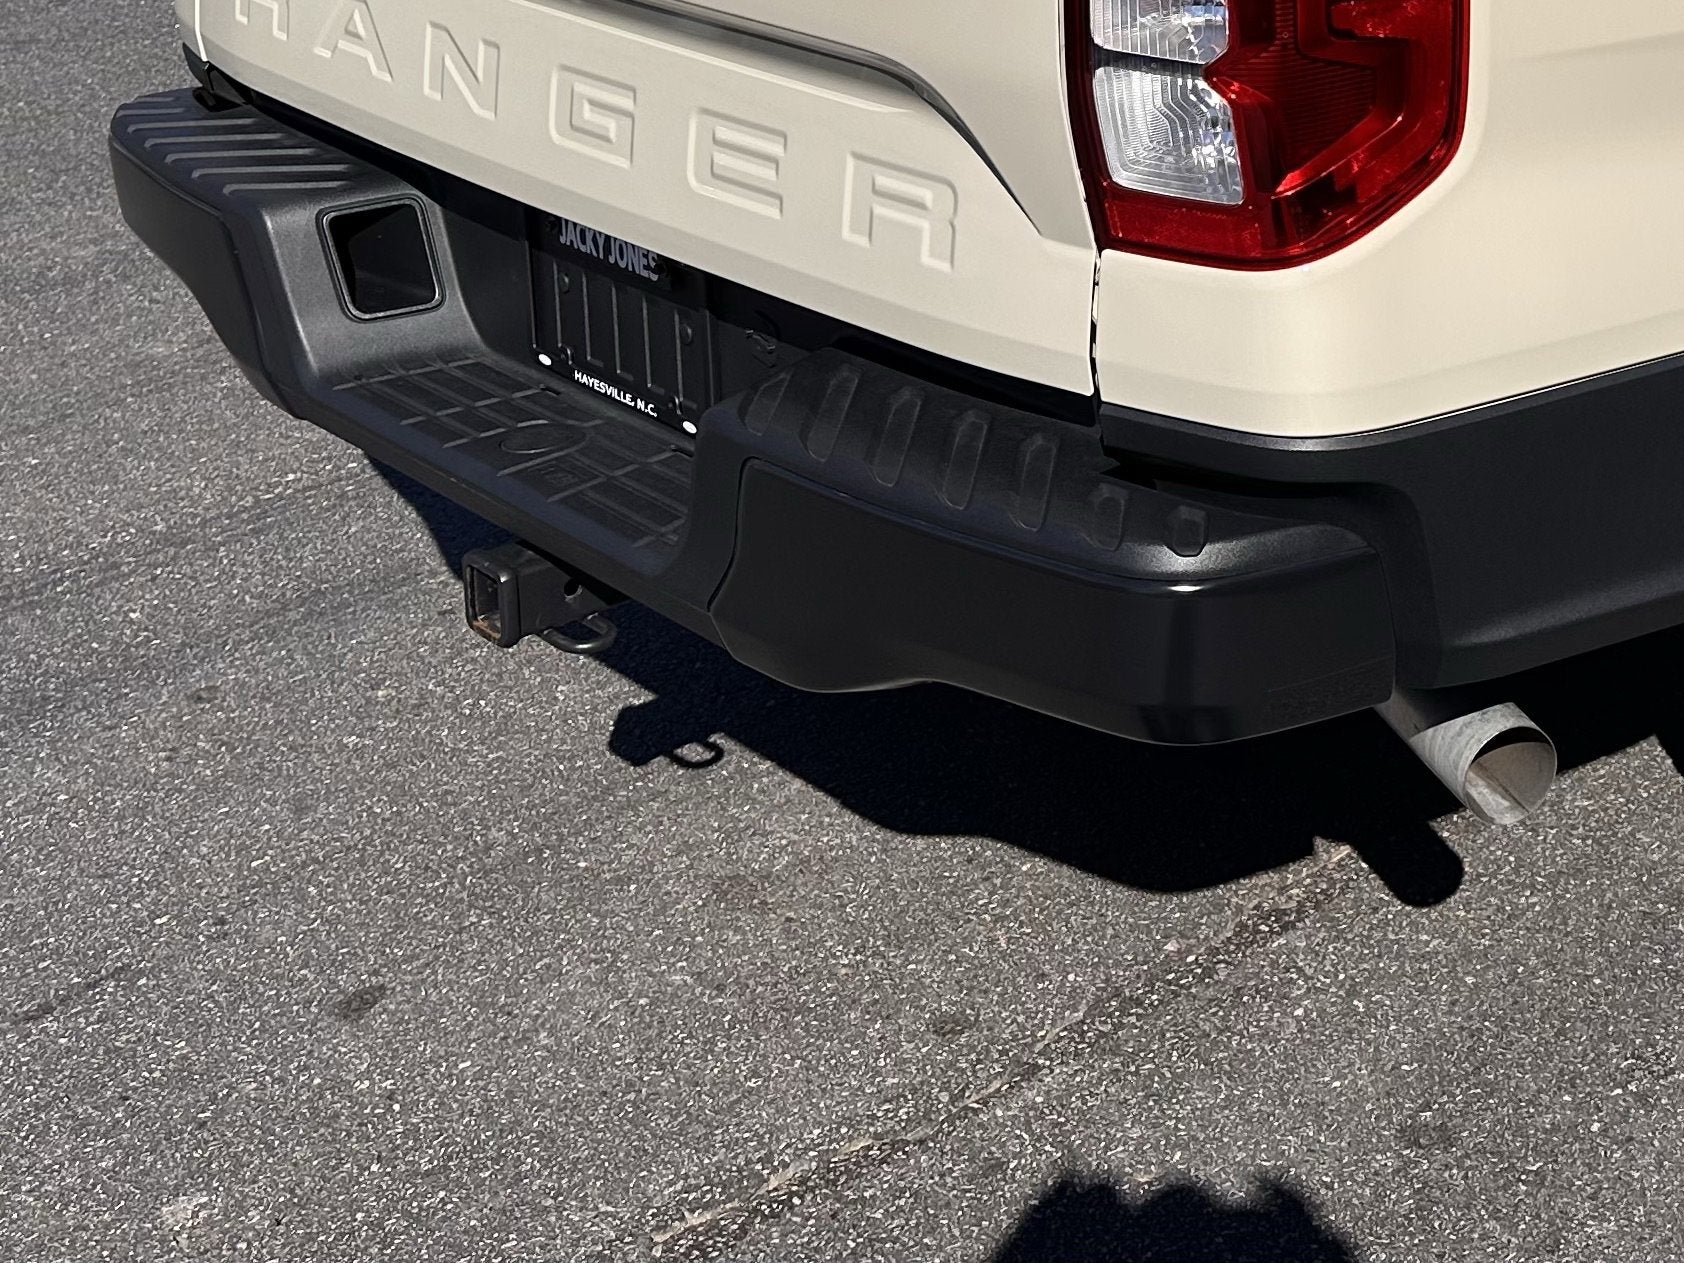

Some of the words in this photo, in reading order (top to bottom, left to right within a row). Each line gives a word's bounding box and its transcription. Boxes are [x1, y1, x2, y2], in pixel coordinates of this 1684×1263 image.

[559, 217, 606, 260] JACKY
[608, 237, 660, 282] JONES
[574, 369, 635, 407] HAYESVILLE,
[636, 398, 658, 418] N.C.
